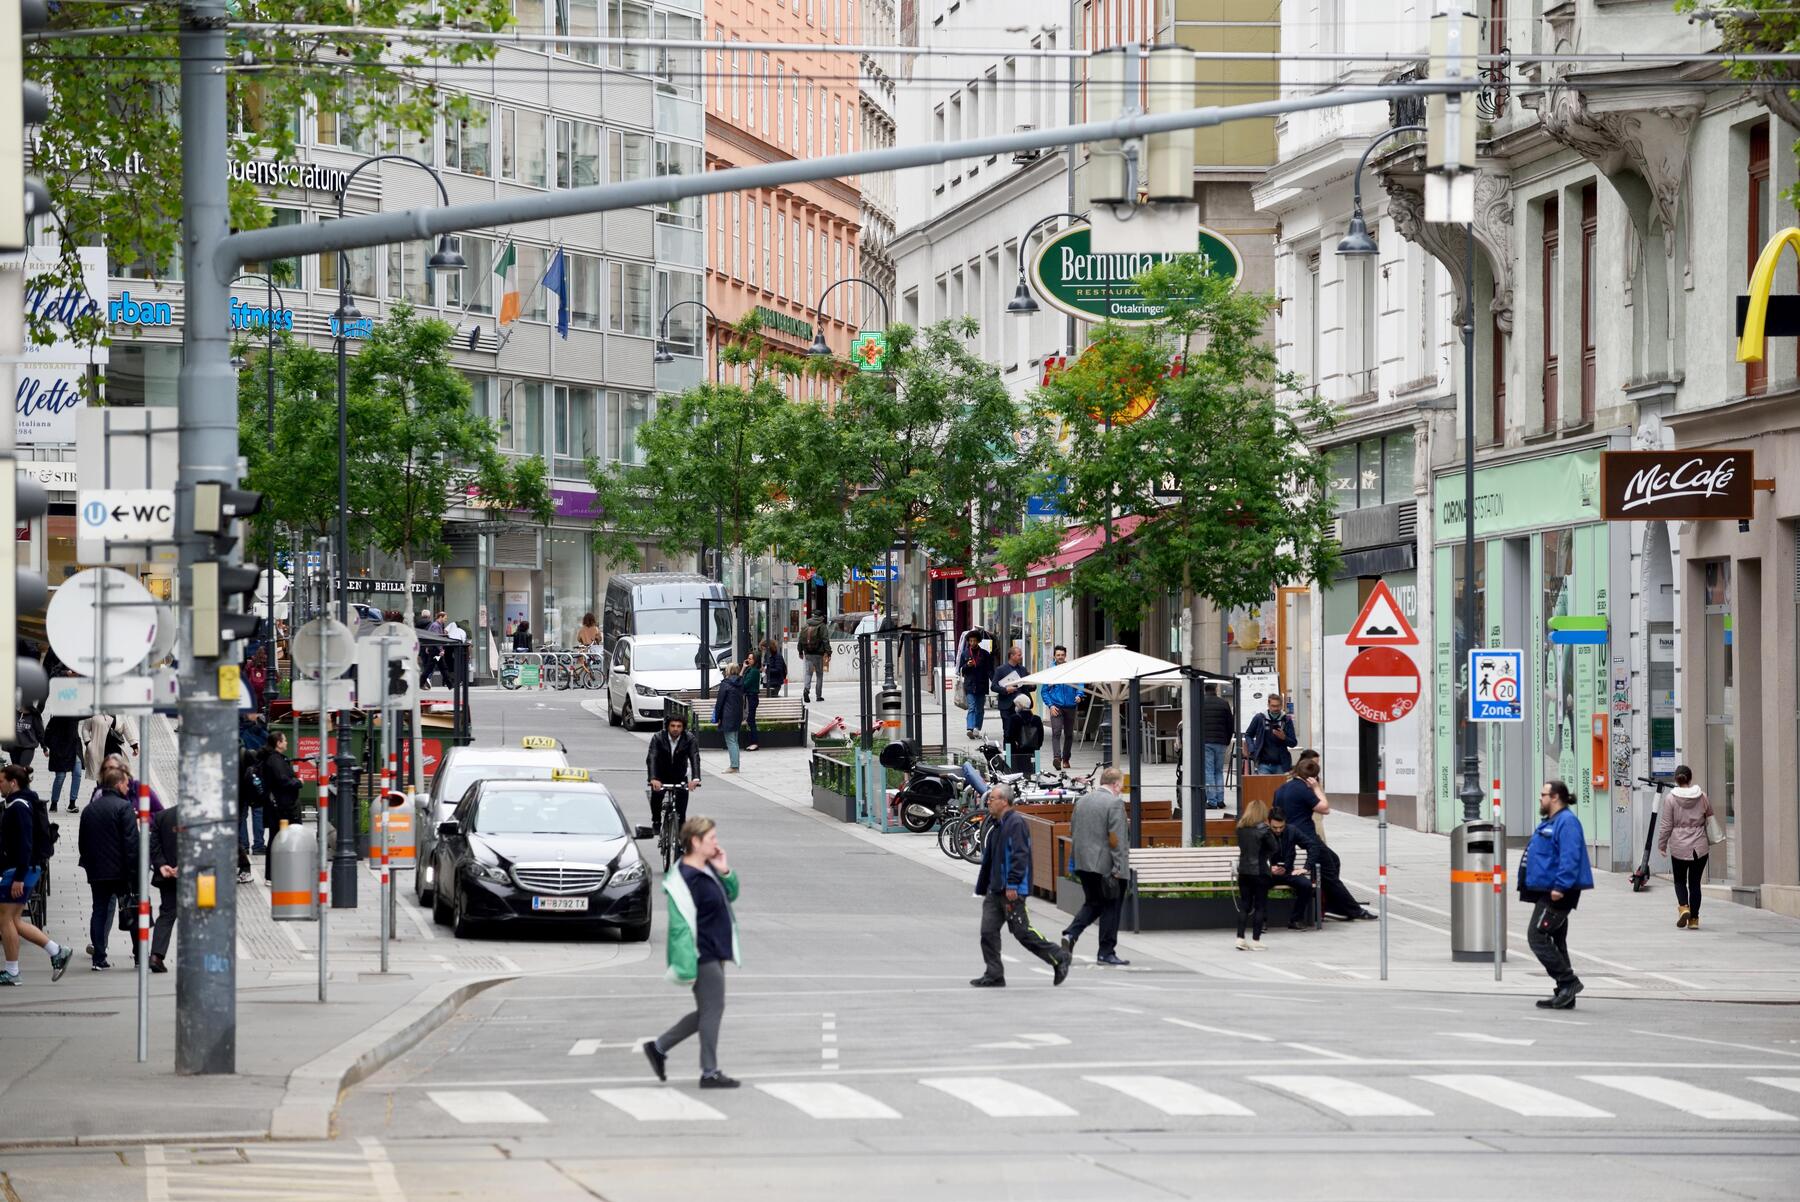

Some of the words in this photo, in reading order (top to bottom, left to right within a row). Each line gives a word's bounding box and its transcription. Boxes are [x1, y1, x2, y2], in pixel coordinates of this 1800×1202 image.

[1111, 302, 1165, 316] Ottakringer
[1623, 457, 1735, 505] McCafé
[133, 505, 171, 522] WC
[375, 581, 427, 593] BRILLATEN
[1500, 685, 1514, 697] 20
[1350, 697, 1391, 721] AUSGEN.
[1481, 703, 1512, 716] Zone
[527, 737, 552, 747] TAXI
[558, 770, 584, 778] TAXI
